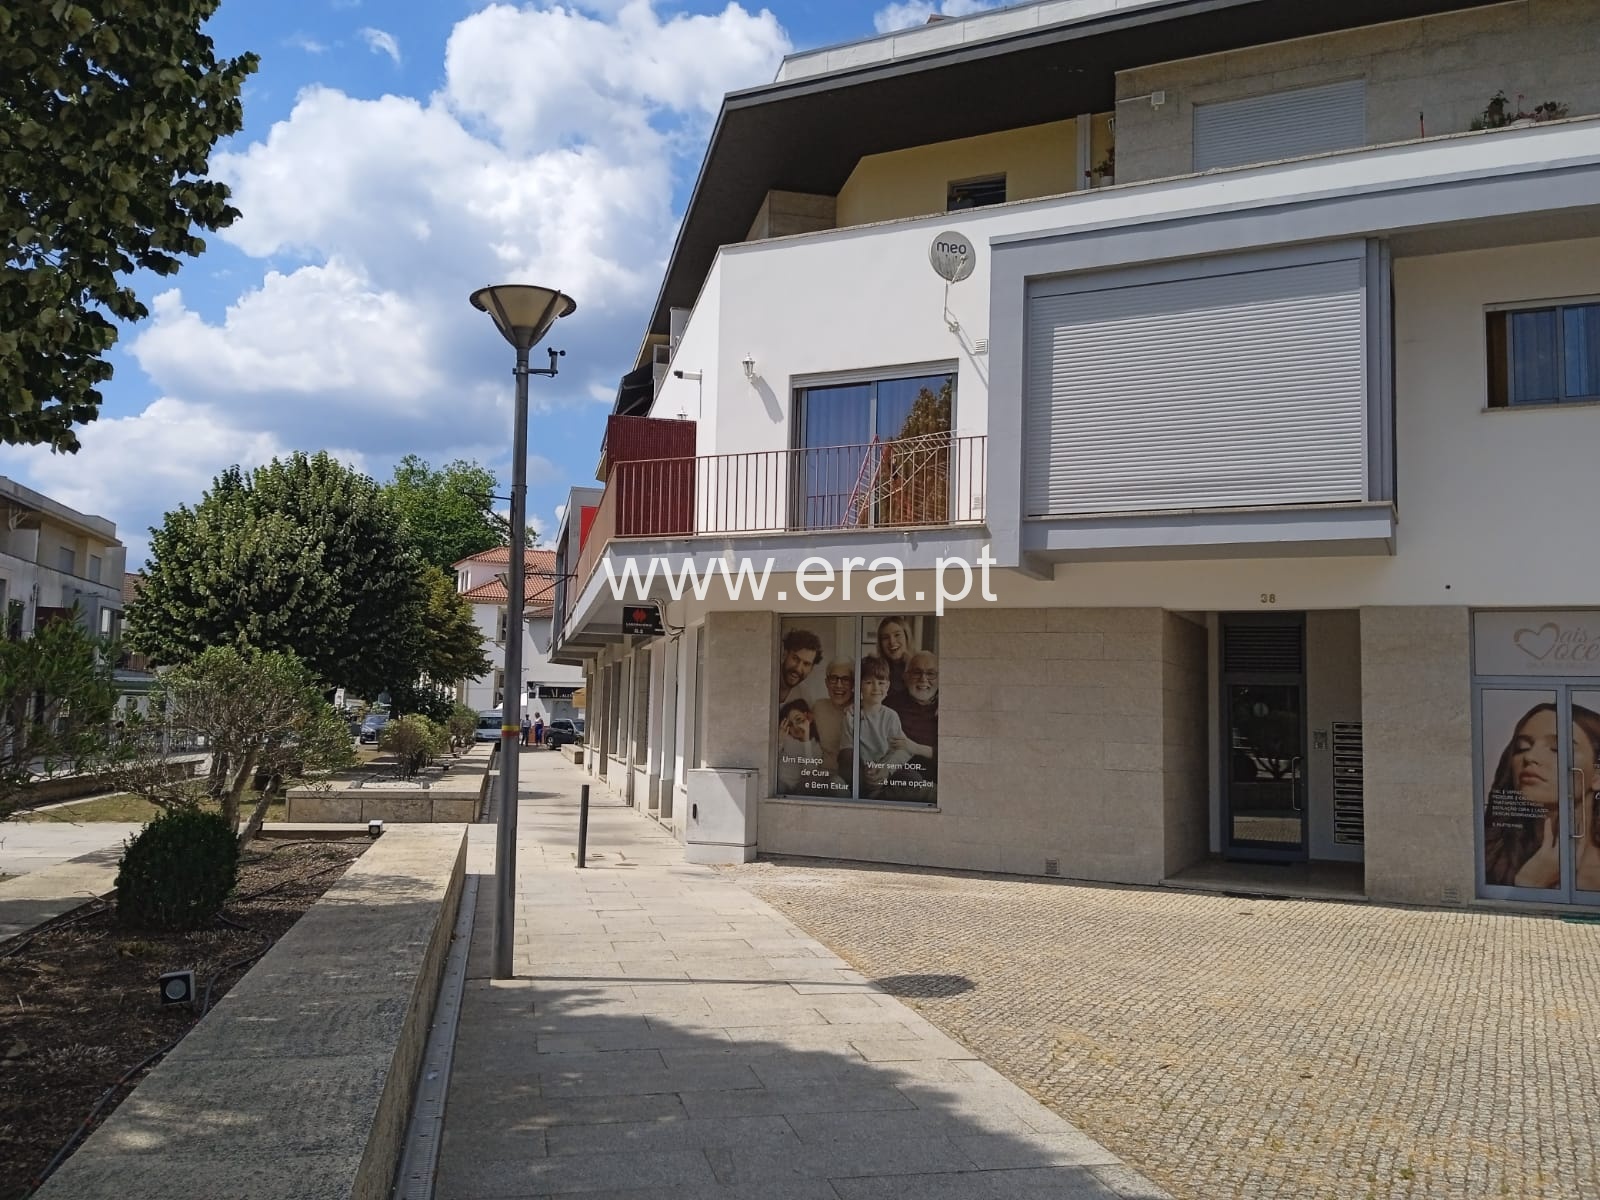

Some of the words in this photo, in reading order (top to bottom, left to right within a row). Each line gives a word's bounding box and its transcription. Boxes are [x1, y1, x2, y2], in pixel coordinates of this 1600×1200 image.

[937, 242, 967, 254] meo
[1260, 593, 1276, 604] 38
[797, 757, 823, 765] Espaço
[867, 761, 885, 769] Viver
[812, 769, 830, 777] Cura
[830, 782, 849, 790] Estar
